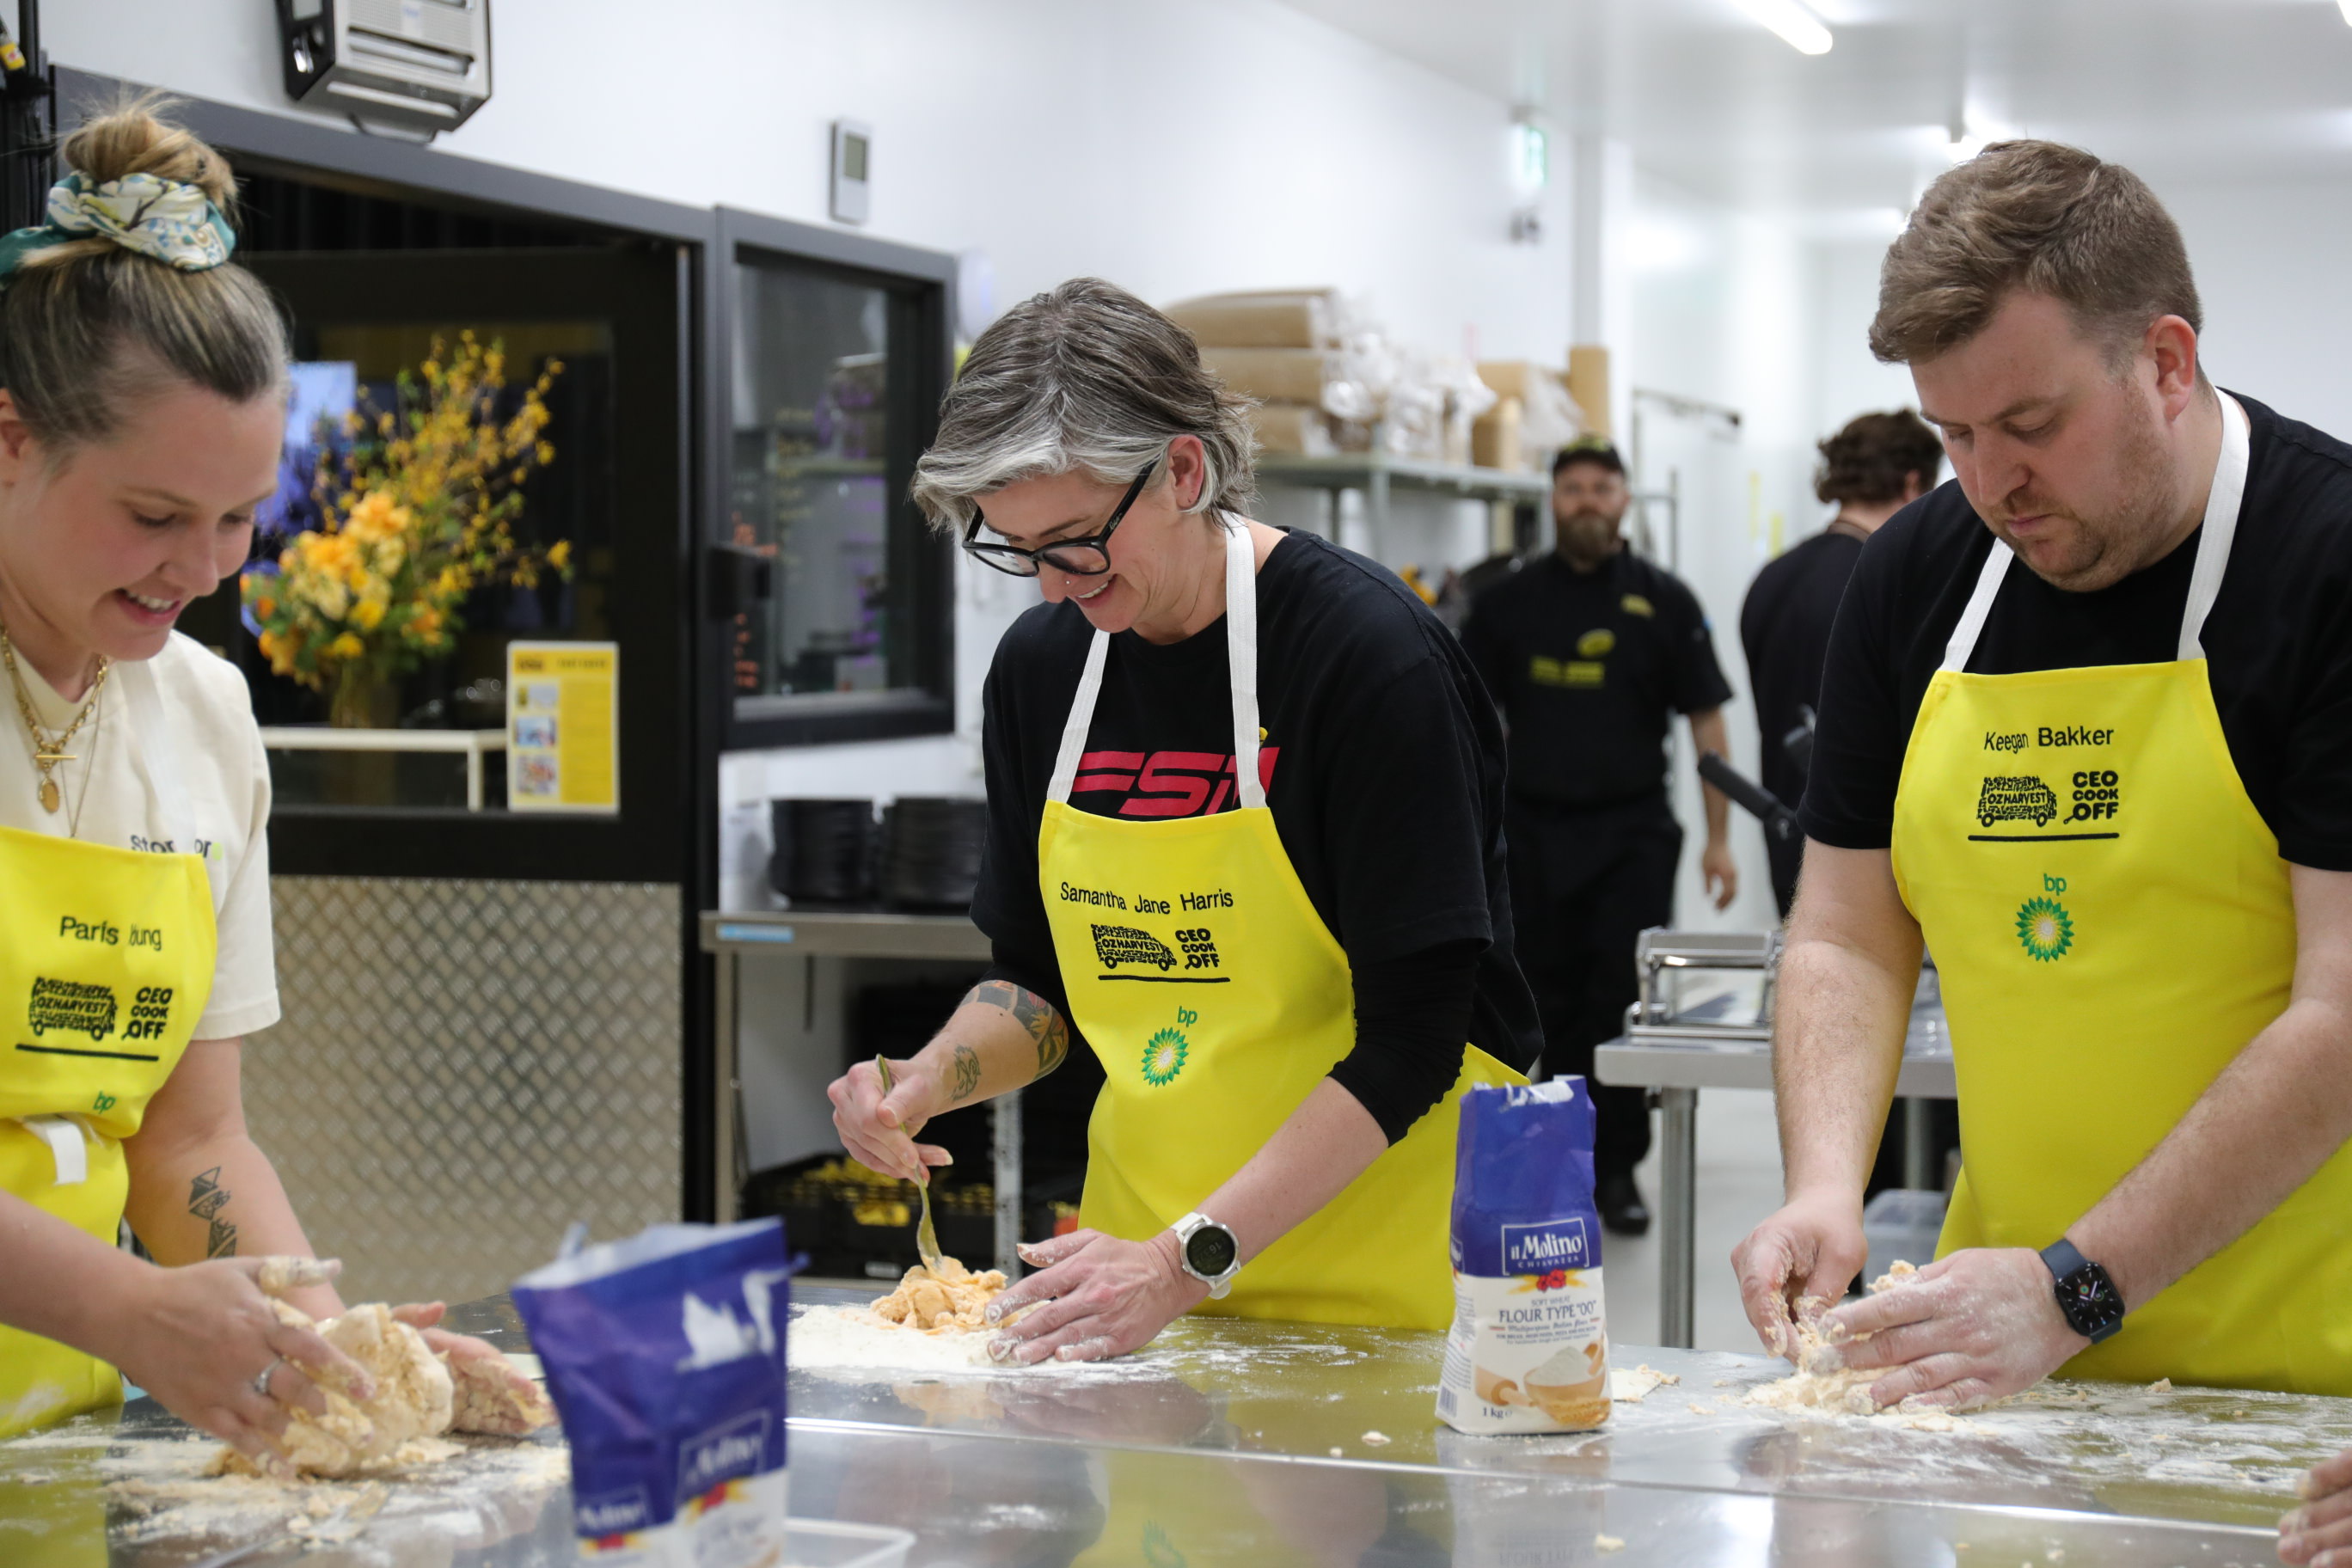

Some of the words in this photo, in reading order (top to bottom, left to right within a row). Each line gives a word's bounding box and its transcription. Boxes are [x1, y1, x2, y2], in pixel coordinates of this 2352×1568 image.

[1983, 731, 2030, 755] Keegan
[2037, 726, 2115, 747] Bakker
[2072, 770, 2118, 787] CEO
[1988, 792, 2046, 805] OZHARVEST
[2072, 788, 2119, 801] COOK
[2043, 873, 2067, 896] bp
[1060, 881, 1127, 911] Samantha
[1134, 894, 1171, 915] Jane
[1179, 888, 1234, 911] Harris
[59, 916, 119, 946] Paris
[1174, 928, 1211, 943] CEO
[1101, 938, 1161, 952] OZHARVEST
[1181, 942, 1216, 953] COOK
[136, 987, 173, 1004] CEO
[37, 996, 108, 1014] OZHARVEST
[131, 1005, 169, 1019] COOK
[1177, 1005, 1198, 1027] bp
[93, 1090, 117, 1114] bp
[1521, 1231, 1582, 1260] Molino
[1498, 1308, 1543, 1324] FLOUR
[1547, 1304, 1576, 1321] TYPE
[1482, 1406, 1487, 1417] 1
[1491, 1406, 1504, 1420] kg
